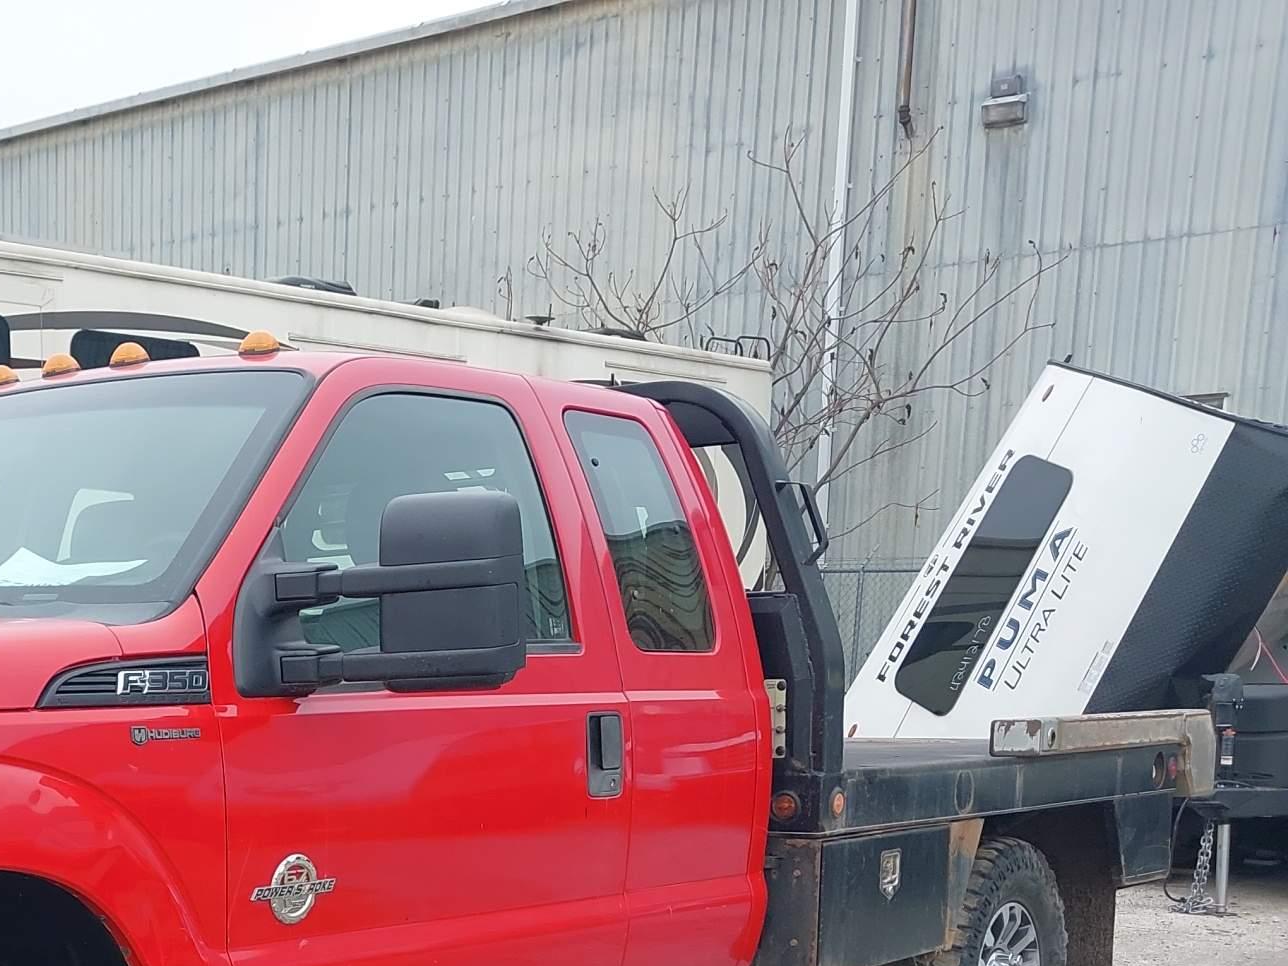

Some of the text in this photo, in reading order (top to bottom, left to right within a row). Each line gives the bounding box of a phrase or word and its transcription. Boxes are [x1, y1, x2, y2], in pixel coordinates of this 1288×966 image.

[875, 448, 1016, 684] FOREST RIVER
[977, 527, 1074, 690] PUMA
[1004, 541, 1088, 690] ULTRA LITE
[117, 669, 209, 694] F-350
